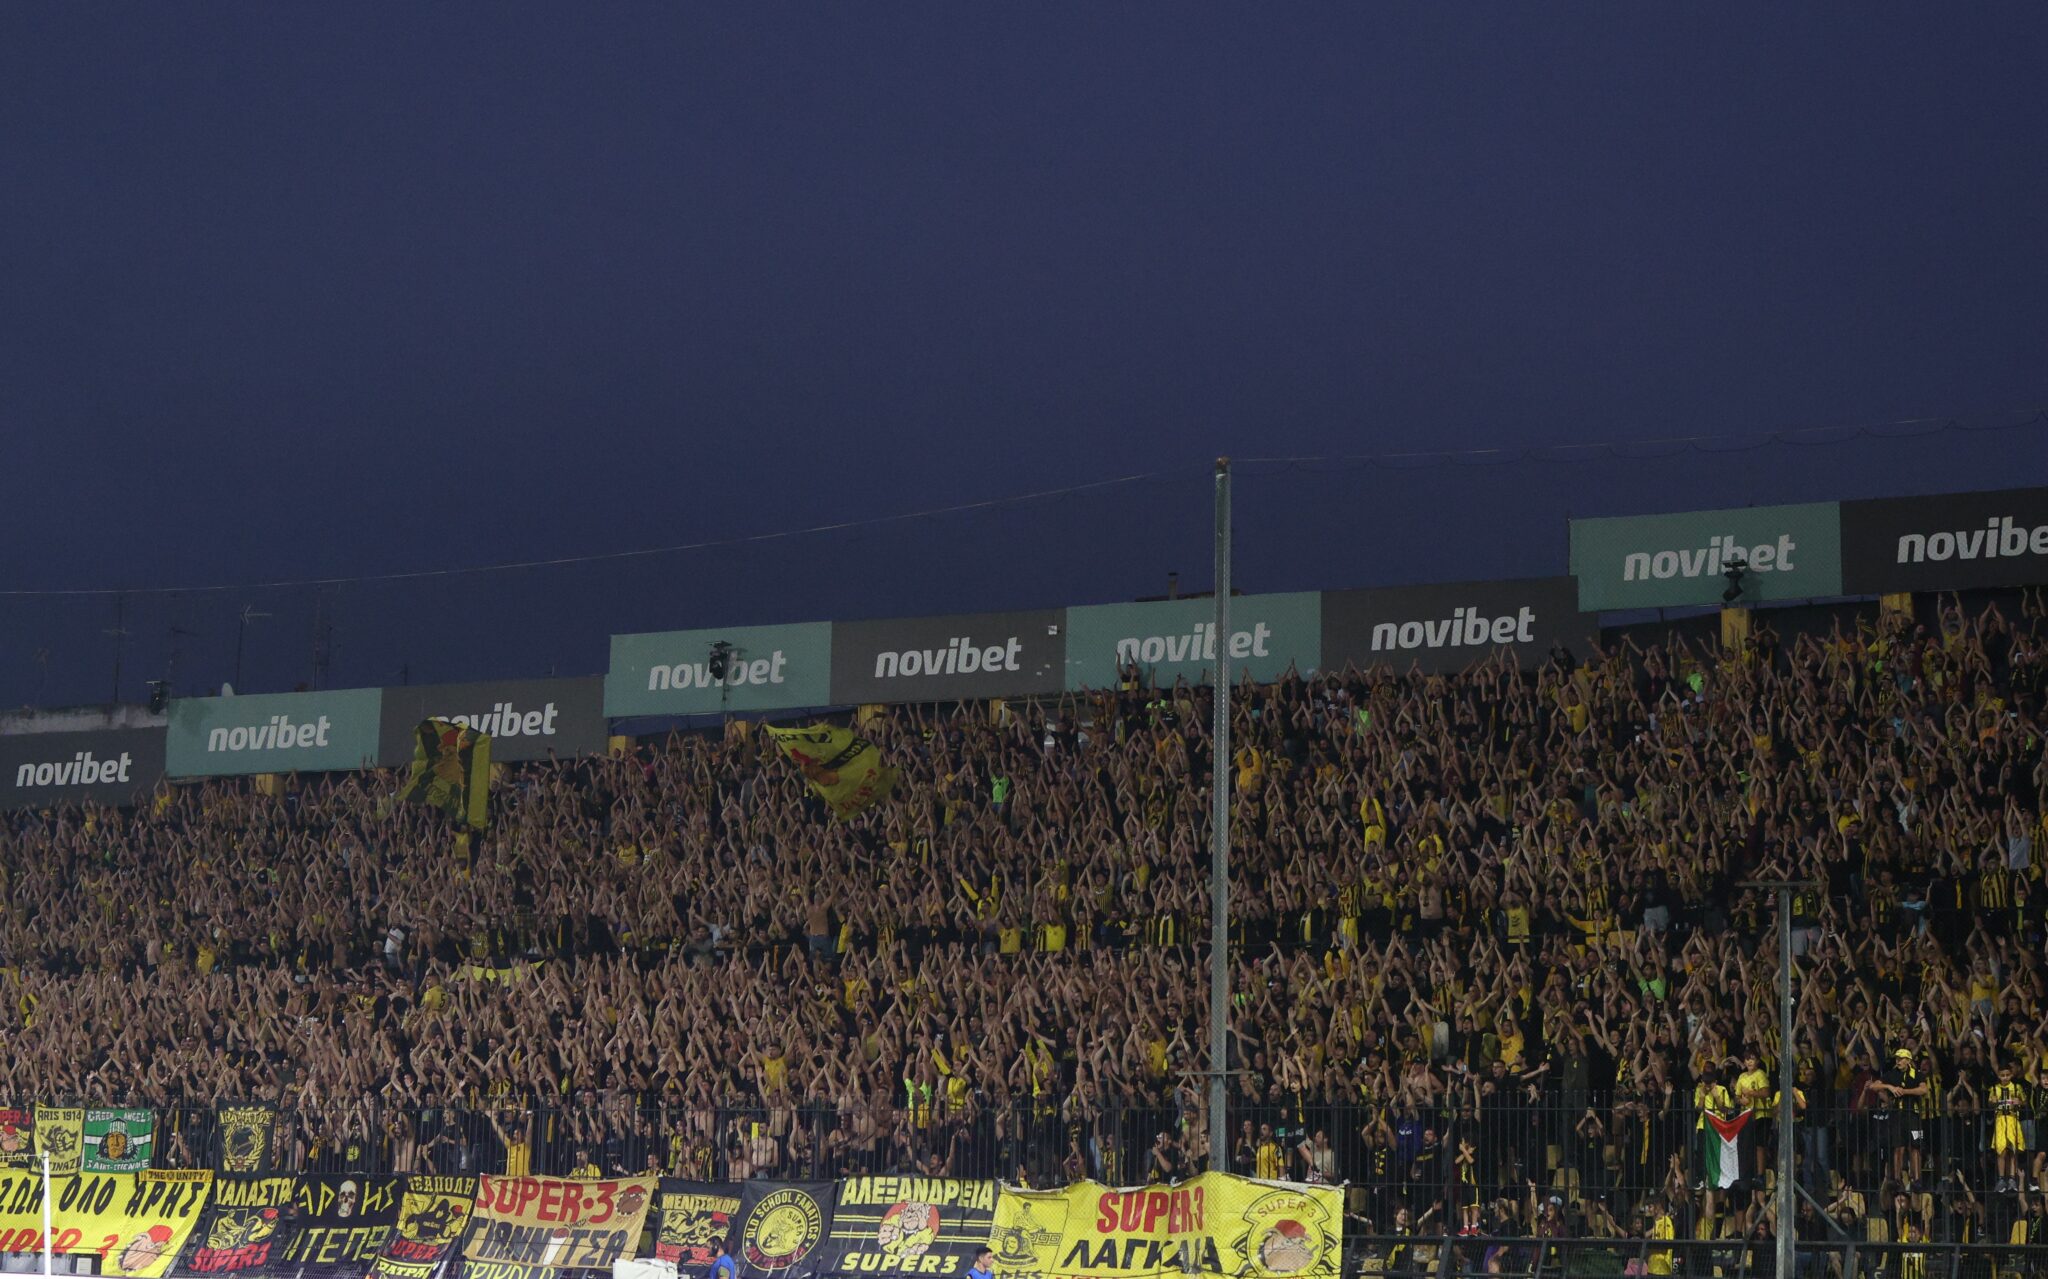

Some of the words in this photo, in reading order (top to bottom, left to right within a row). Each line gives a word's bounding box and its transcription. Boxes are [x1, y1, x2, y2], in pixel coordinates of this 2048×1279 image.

[1623, 534, 1796, 581] novibet
[1371, 606, 1534, 651] novibet
[874, 637, 1022, 678] novibet
[208, 715, 331, 752] novibet
[16, 752, 132, 788] novibet
[37, 1110, 59, 1121] ARIS
[746, 1219, 759, 1238] OLD
[756, 1192, 792, 1217] SCHOOL
[794, 1194, 818, 1240] FANATICS
[1257, 1198, 1306, 1218] SUPER
